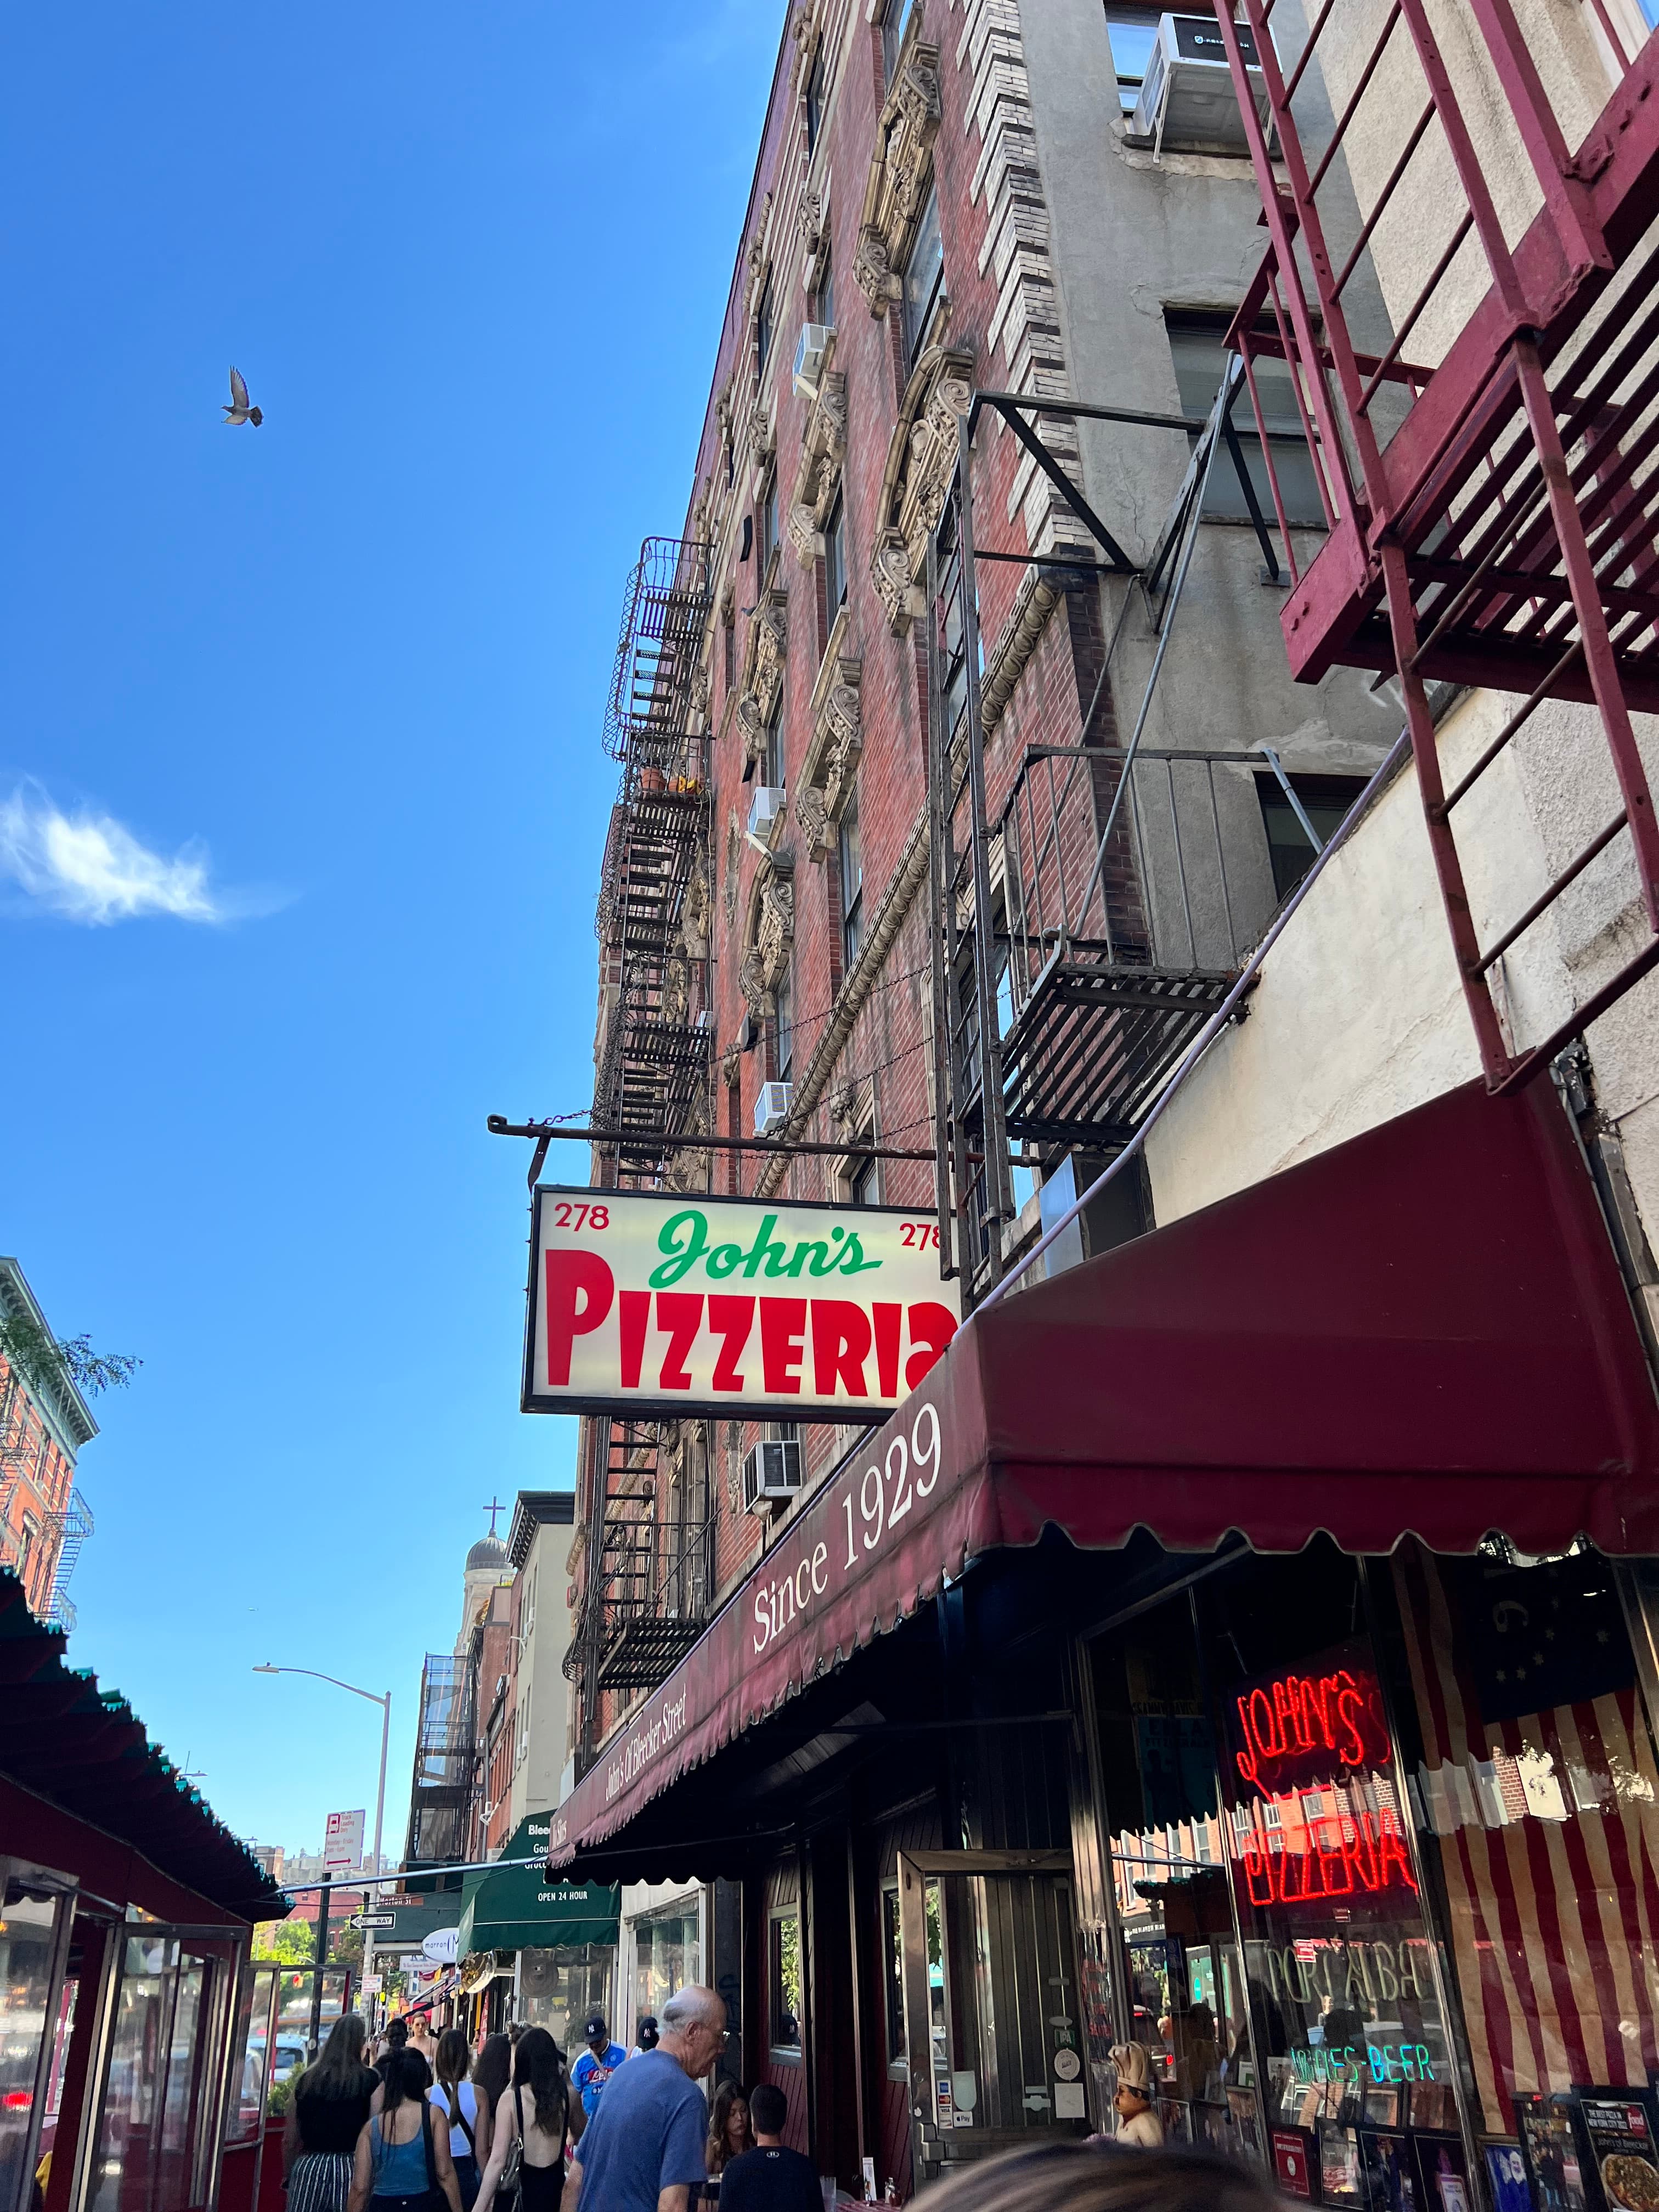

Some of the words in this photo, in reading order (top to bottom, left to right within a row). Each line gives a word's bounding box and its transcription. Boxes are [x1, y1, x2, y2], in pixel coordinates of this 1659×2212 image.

[555, 1203, 610, 1232] 278
[649, 1210, 883, 1289] John's
[753, 1541, 828, 1655] Since
[842, 1402, 941, 1570] 1929
[606, 1756, 624, 1801] John's
[625, 1740, 634, 1783] Of
[633, 1720, 662, 1776] Bleecker
[662, 1683, 687, 1745] Street
[1236, 1669, 1364, 1783] JOHN'S
[380, 1897, 403, 1905] Morton
[405, 1896, 411, 1905] St
[538, 1893, 556, 1901] OPEN
[558, 1892, 567, 1900] 24
[569, 1891, 588, 1900] HOUR
[1242, 1808, 1418, 1906] PIZZERIA
